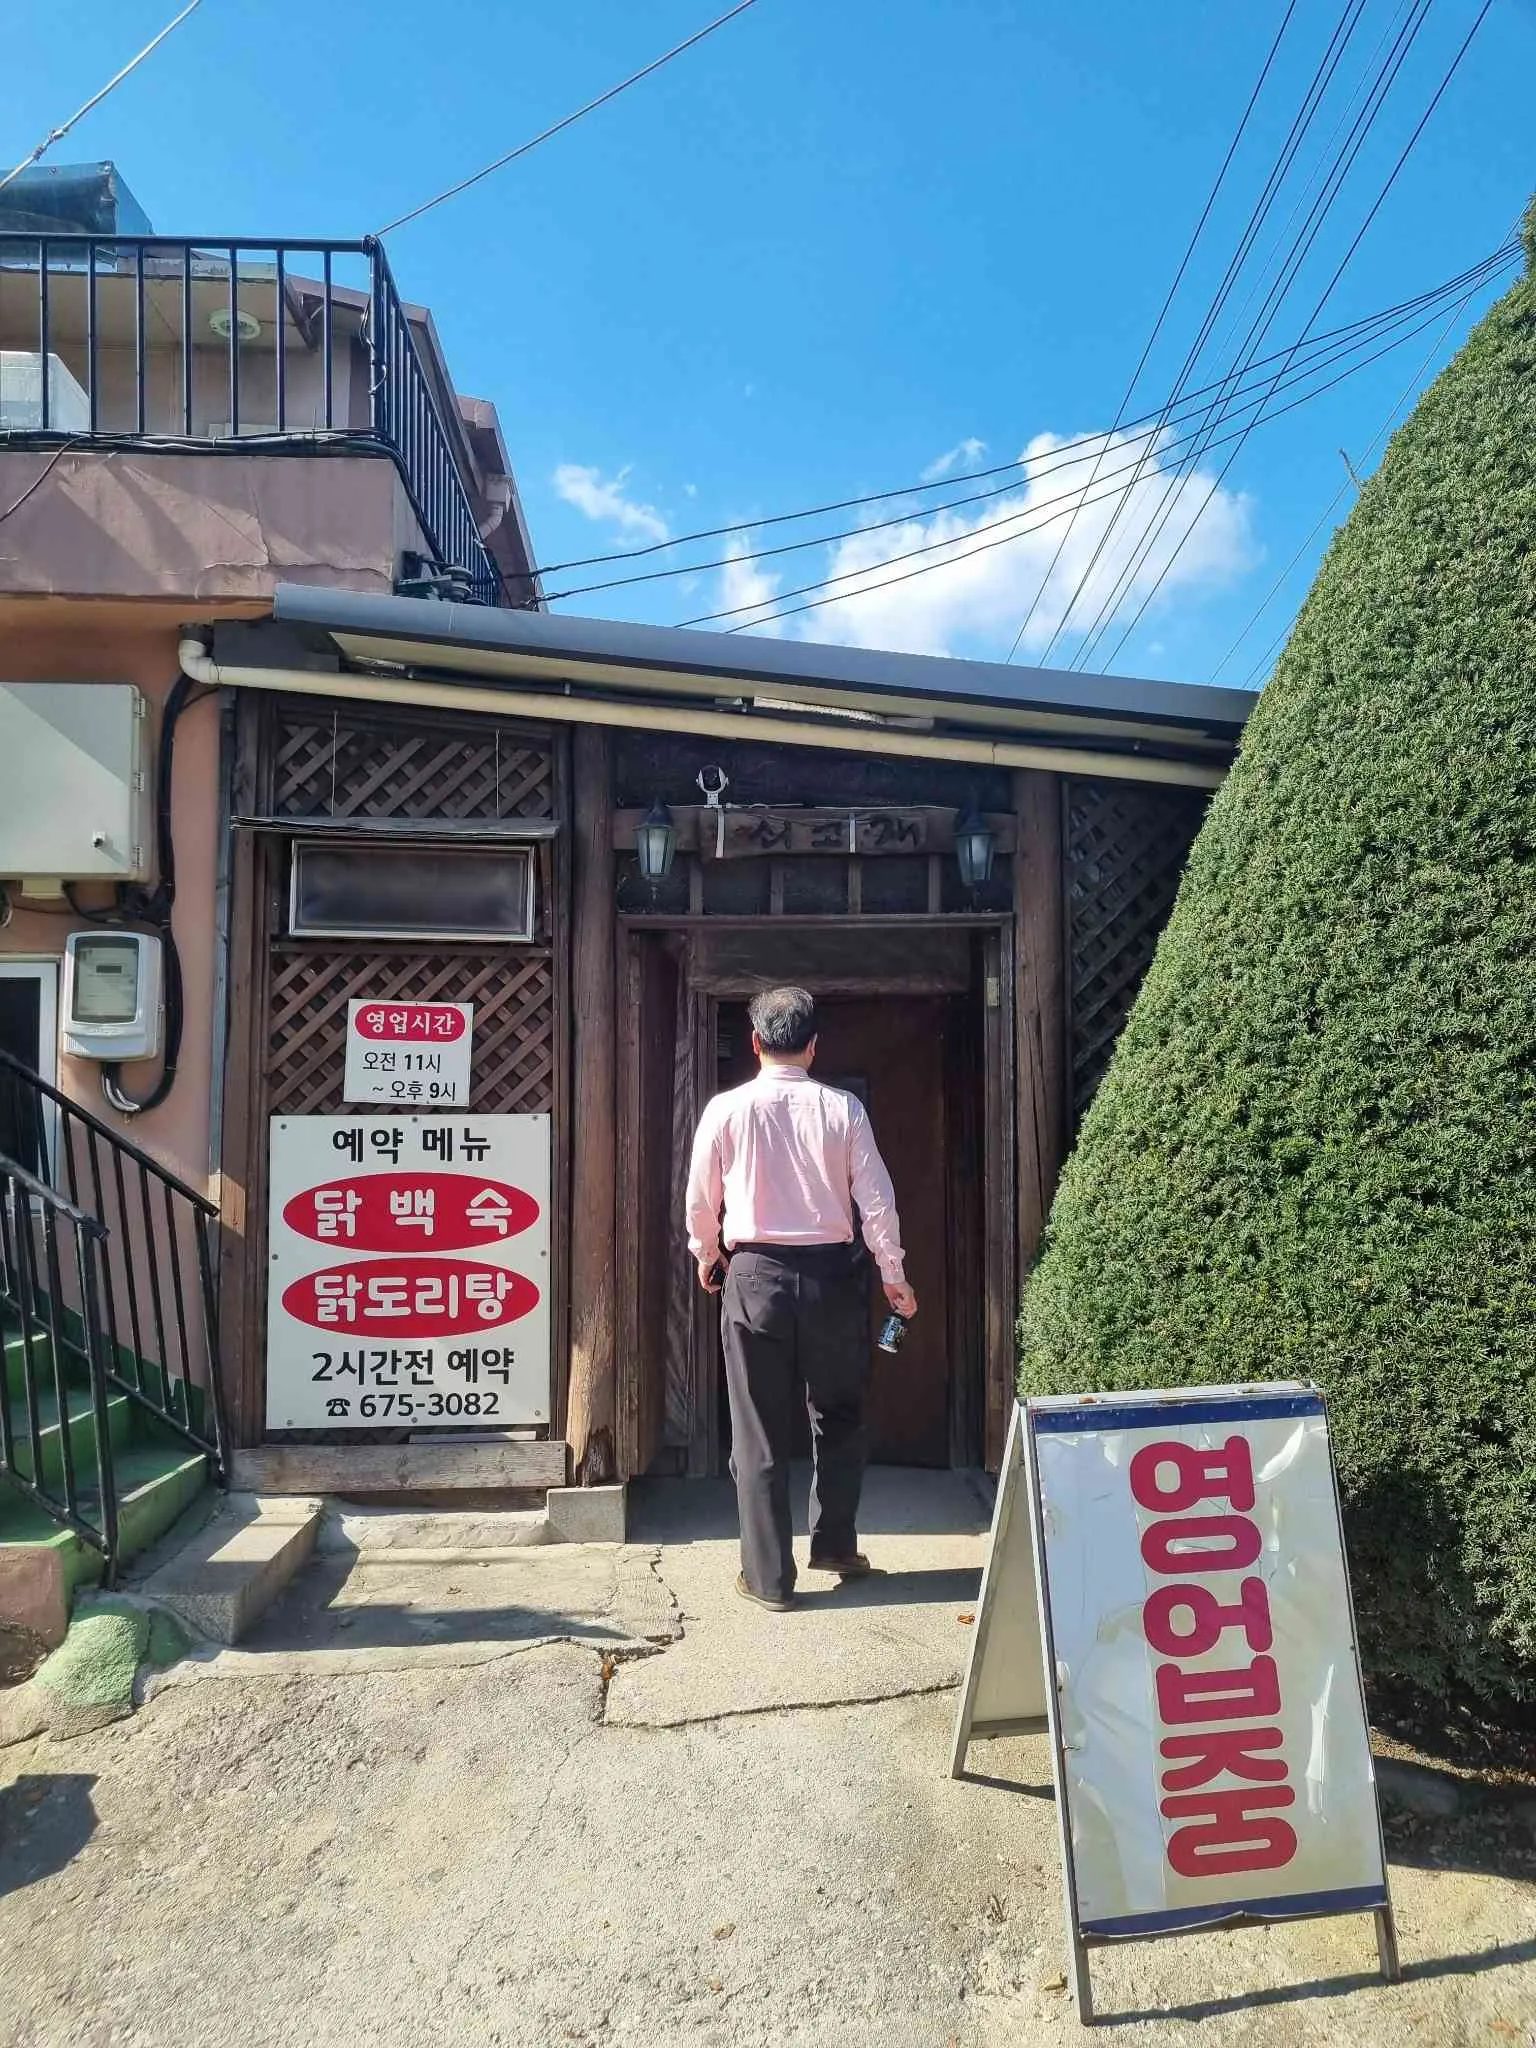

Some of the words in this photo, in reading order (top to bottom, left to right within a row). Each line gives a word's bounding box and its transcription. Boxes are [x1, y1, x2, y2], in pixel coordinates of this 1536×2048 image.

[366, 1009, 456, 1036] 영업시간
[362, 1051, 396, 1072] 오전
[404, 1053, 441, 1074] 11시
[389, 1080, 424, 1101] 오후
[429, 1081, 456, 1102] 9시
[332, 1127, 404, 1165] 예약
[422, 1127, 492, 1163] 메뉴
[313, 1272, 514, 1323] 닭도리탕
[311, 1348, 435, 1386] 2시간전
[447, 1347, 515, 1385] 예약
[359, 1391, 500, 1418] 675-3082
[1130, 1434, 1298, 1879] 영업중
